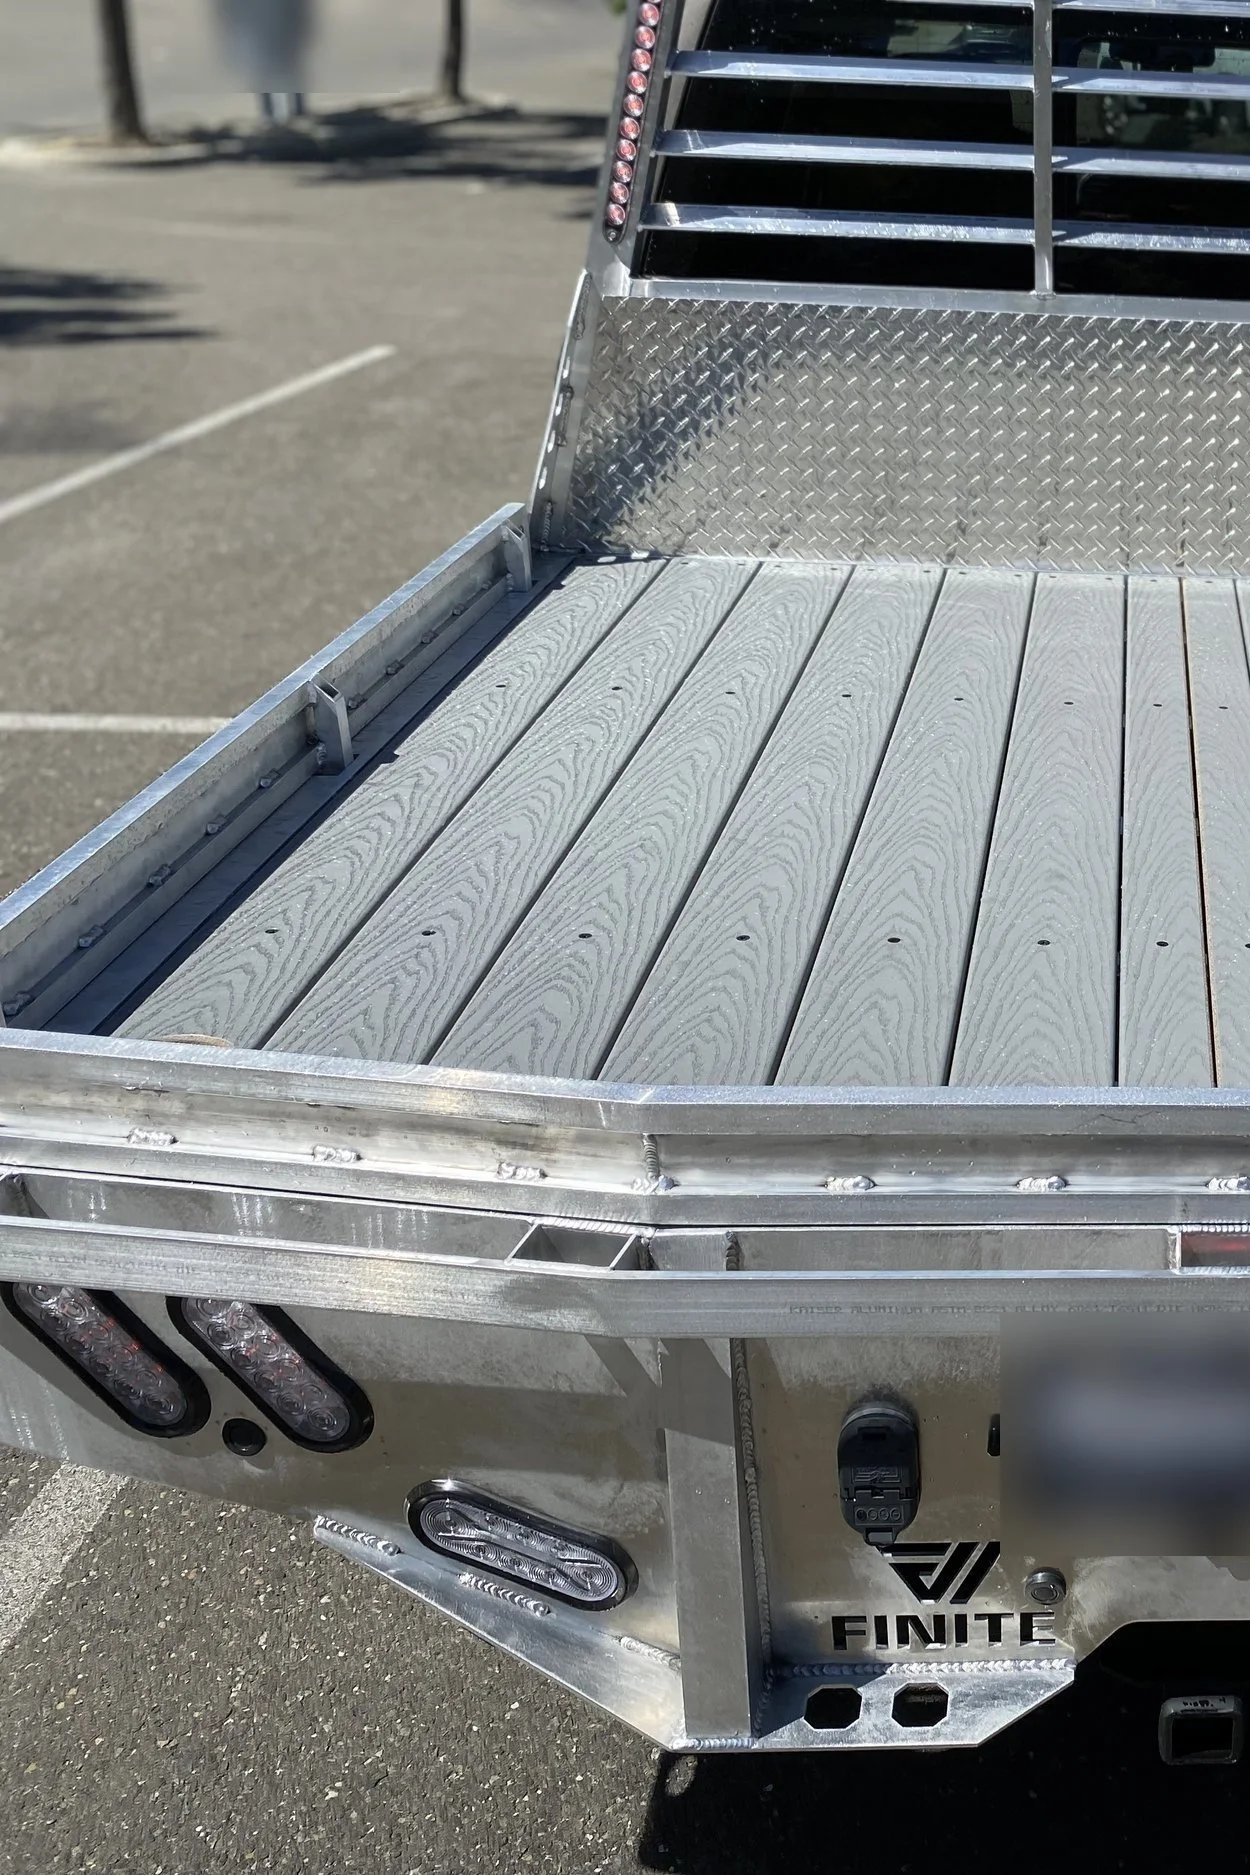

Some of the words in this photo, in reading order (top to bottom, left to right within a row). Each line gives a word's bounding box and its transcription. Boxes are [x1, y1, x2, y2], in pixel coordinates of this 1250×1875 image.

[789, 1304, 842, 1314] KAISER
[850, 1304, 922, 1314] ALUMINUM
[831, 1611, 1056, 1651] FINITE
